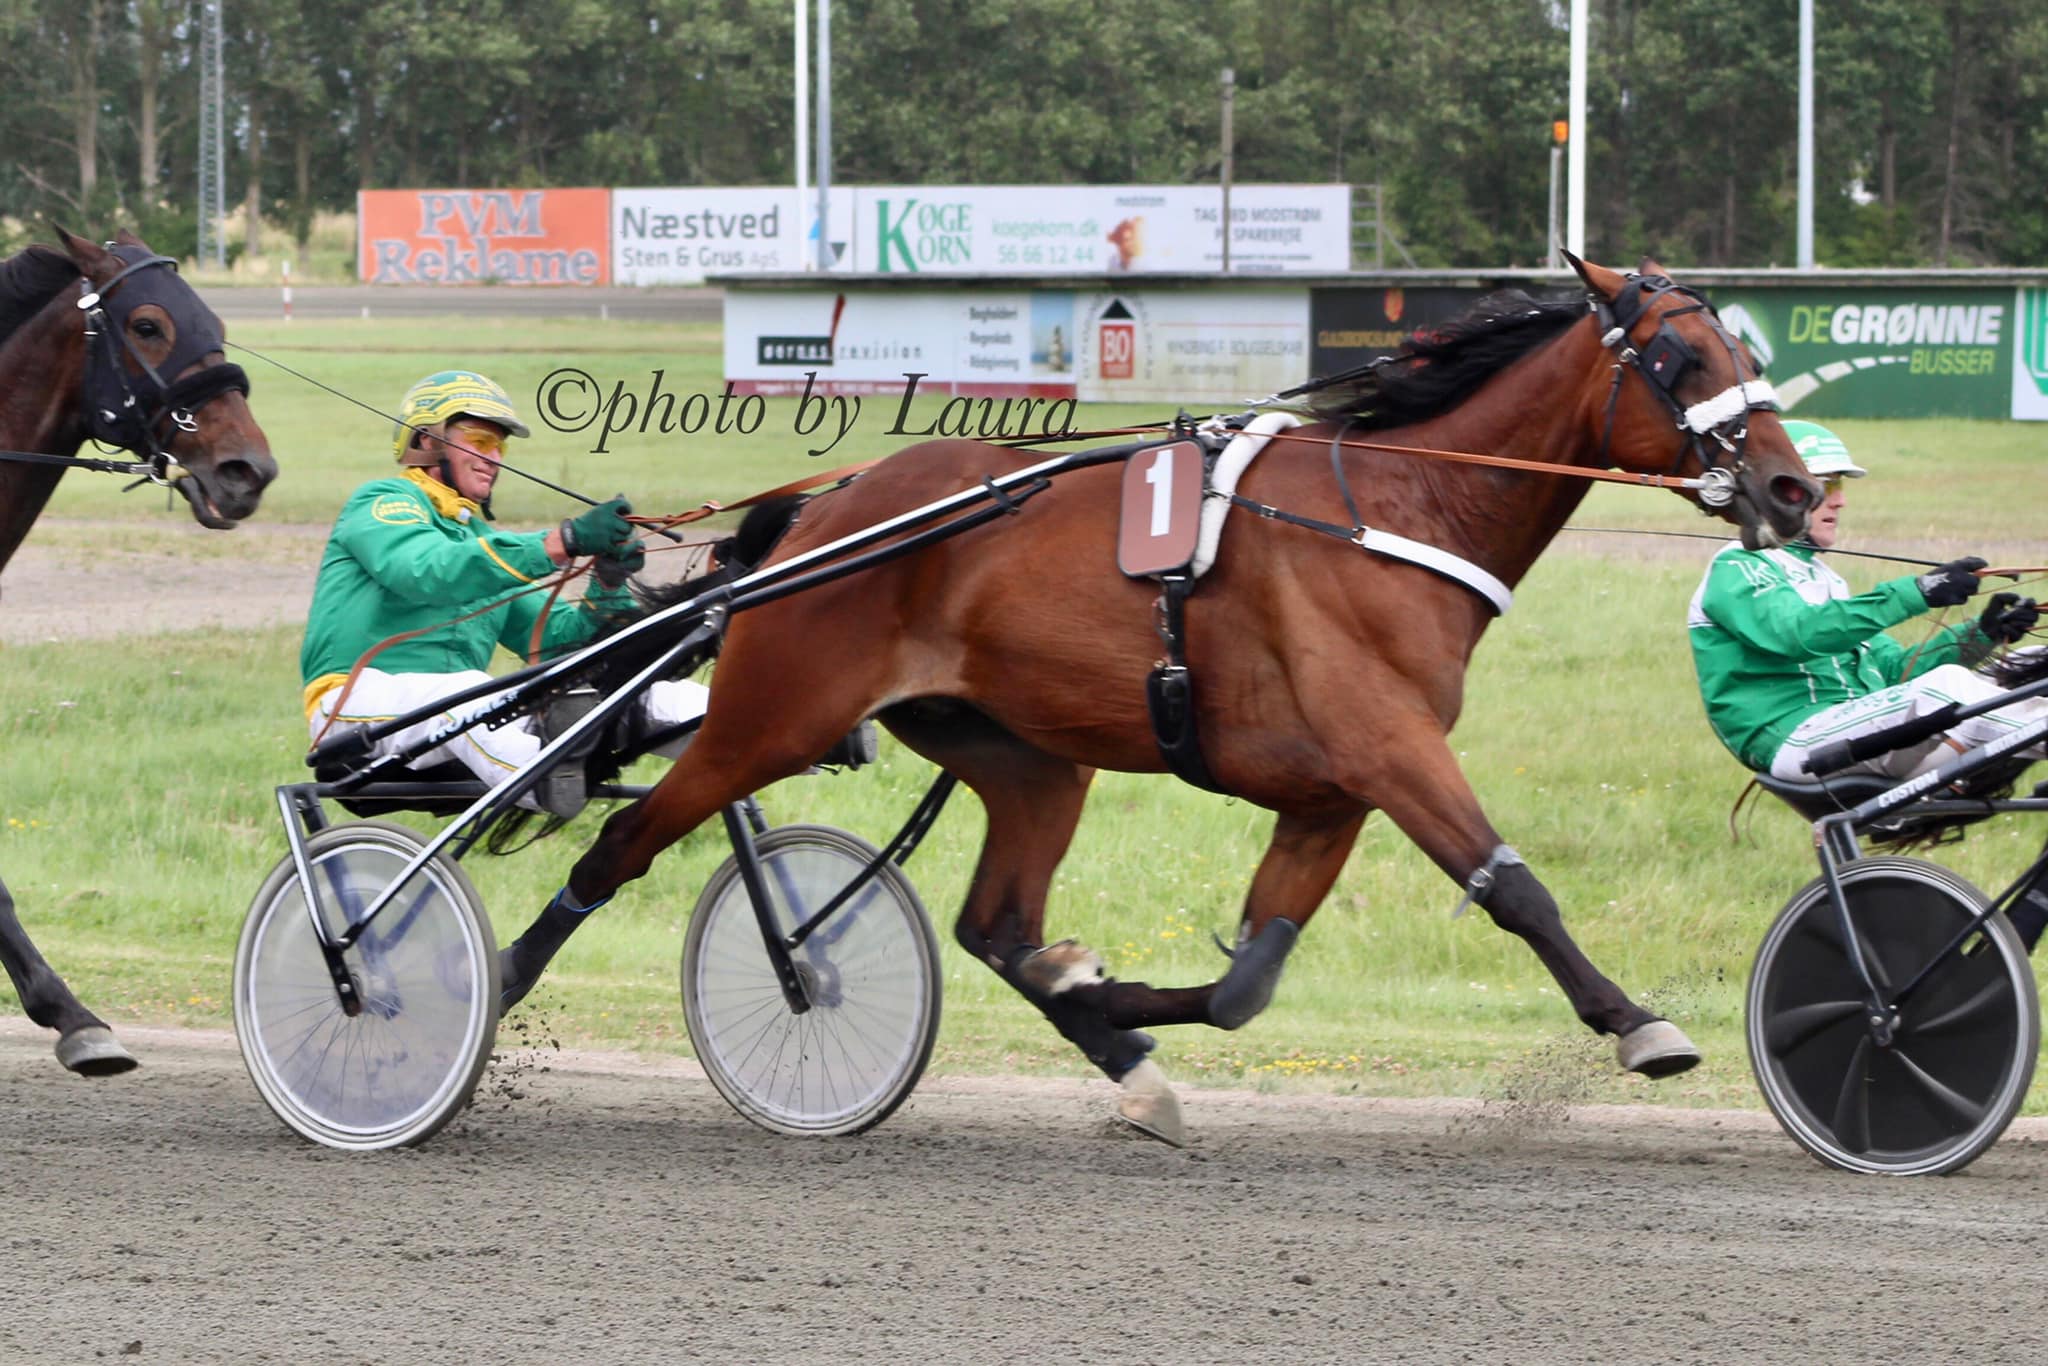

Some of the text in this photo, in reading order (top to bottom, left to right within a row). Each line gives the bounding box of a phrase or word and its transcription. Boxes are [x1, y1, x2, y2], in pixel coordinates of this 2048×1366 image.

[417, 191, 546, 238] PVM
[621, 204, 780, 239] Næstved
[373, 236, 602, 284] Reklame
[623, 247, 670, 268] Sten
[676, 247, 690, 267] &
[697, 247, 744, 268] Grus
[998, 246, 1017, 265] 56
[1050, 246, 1067, 265] 12
[1074, 246, 1094, 265] 44
[1102, 330, 1131, 363] BO
[1908, 349, 1996, 374] BUSSER
[1145, 449, 1173, 537] 1
